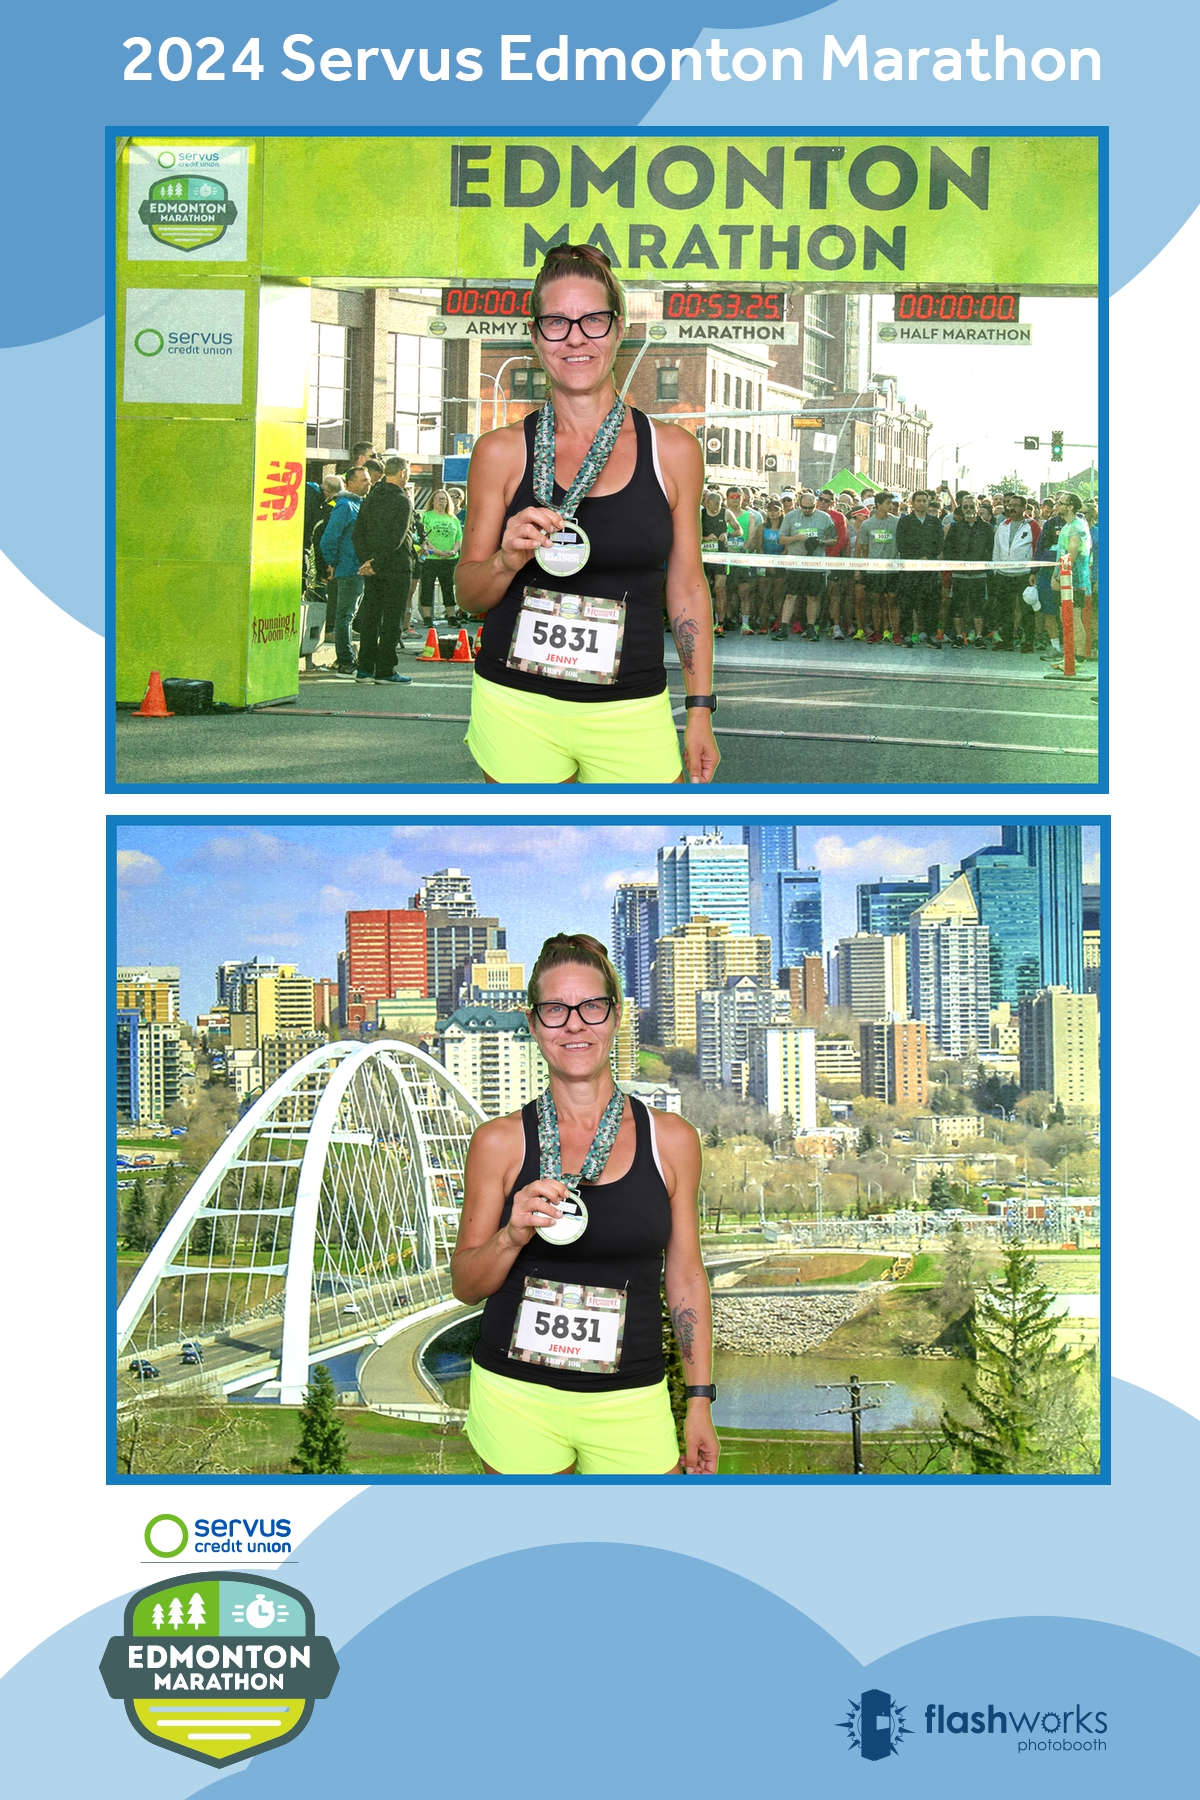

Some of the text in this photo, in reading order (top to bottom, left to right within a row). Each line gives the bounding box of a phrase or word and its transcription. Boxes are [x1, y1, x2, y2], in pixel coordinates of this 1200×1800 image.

[178, 152, 220, 161] servus
[450, 144, 991, 211] EDMONTON
[149, 202, 227, 214] EDMONTON
[160, 214, 216, 222] MARATHON
[522, 222, 907, 274] MARATHON
[465, 321, 518, 336] ARMY
[678, 324, 785, 341] MARATHON
[900, 327, 1031, 342] HALF MARATHON
[168, 331, 233, 345] servus
[168, 345, 233, 355] credit union
[257, 613, 291, 643] Running
[532, 620, 599, 654] 5831
[545, 653, 579, 666] JENNY
[541, 666, 579, 678] ARMY 10K
[534, 1310, 601, 1343] 5831
[548, 1343, 582, 1356] JENNY
[544, 1356, 582, 1368] ARMY 10K
